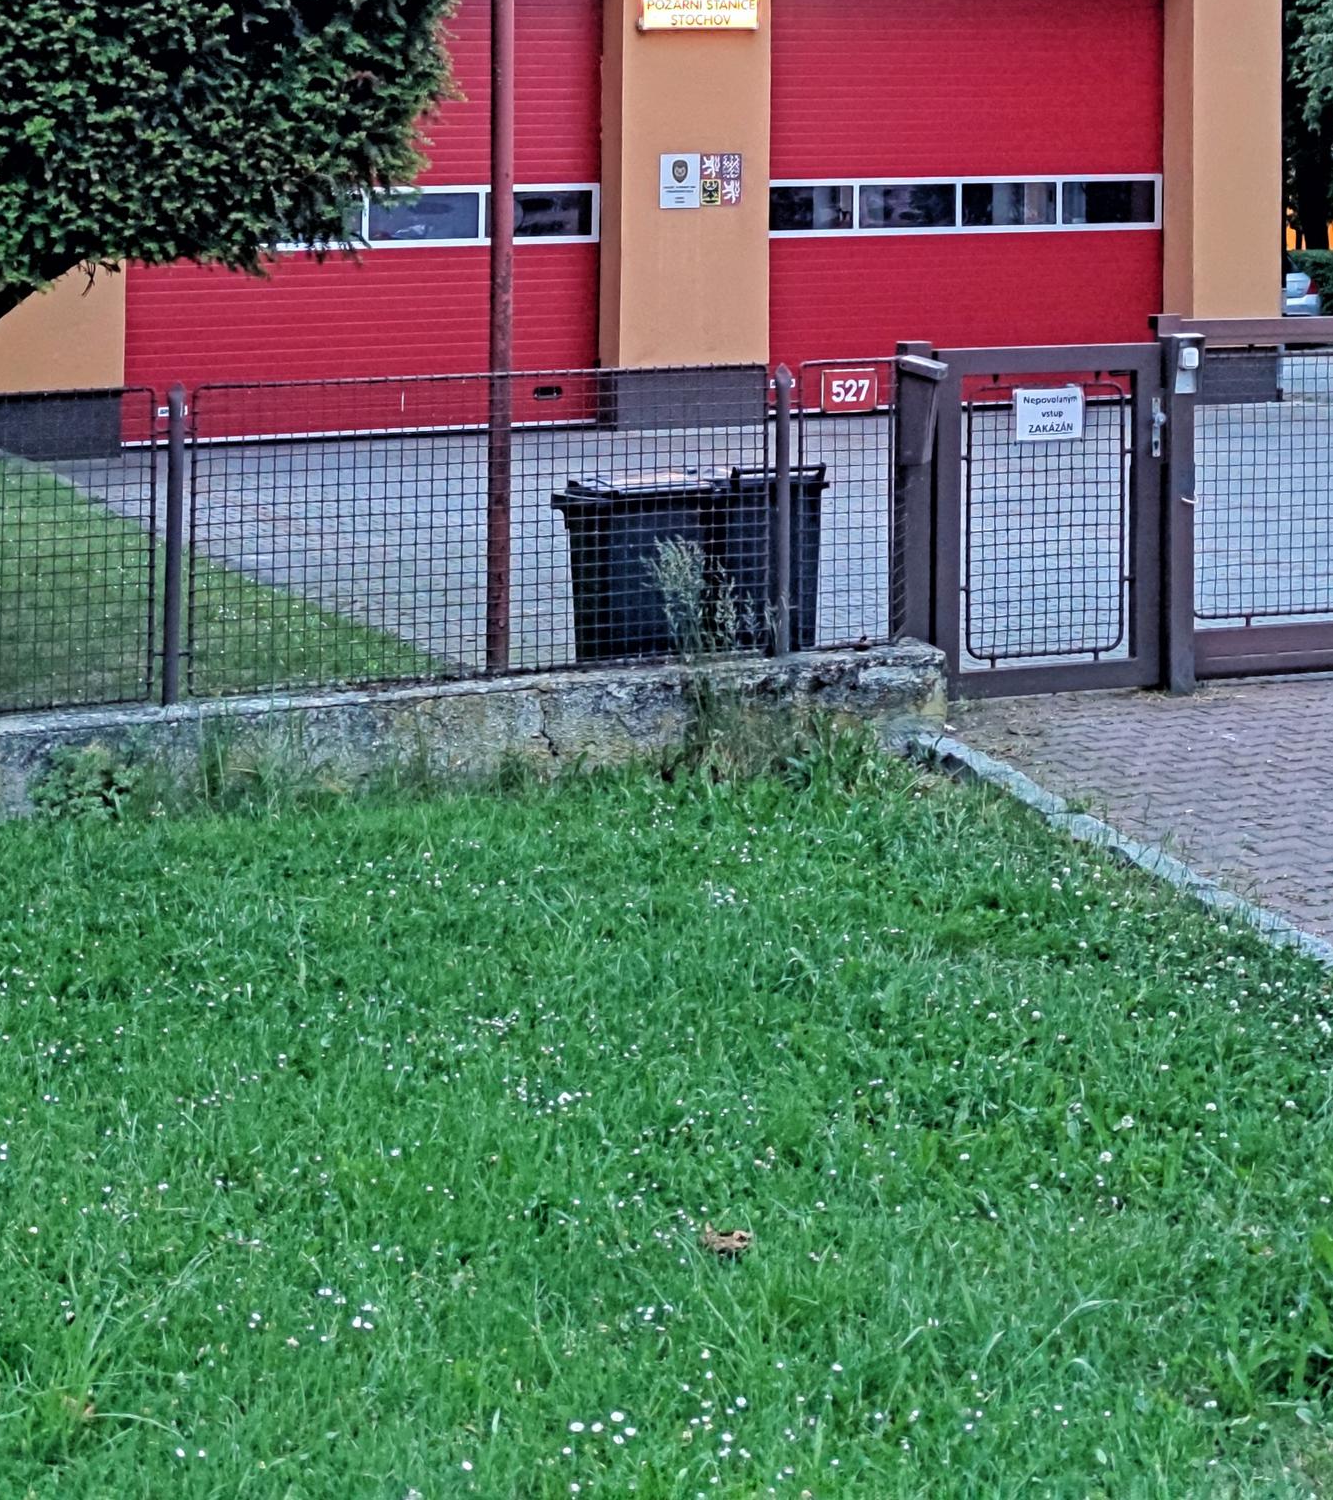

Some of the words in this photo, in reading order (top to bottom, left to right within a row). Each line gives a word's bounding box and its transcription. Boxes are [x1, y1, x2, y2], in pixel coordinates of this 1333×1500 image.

[706, 0, 756, 10] STANICE
[671, 14, 731, 26] STOCHOV
[831, 379, 870, 403] 527
[1041, 410, 1064, 418] vstup
[1028, 421, 1074, 433] ZAKÁZÁN
